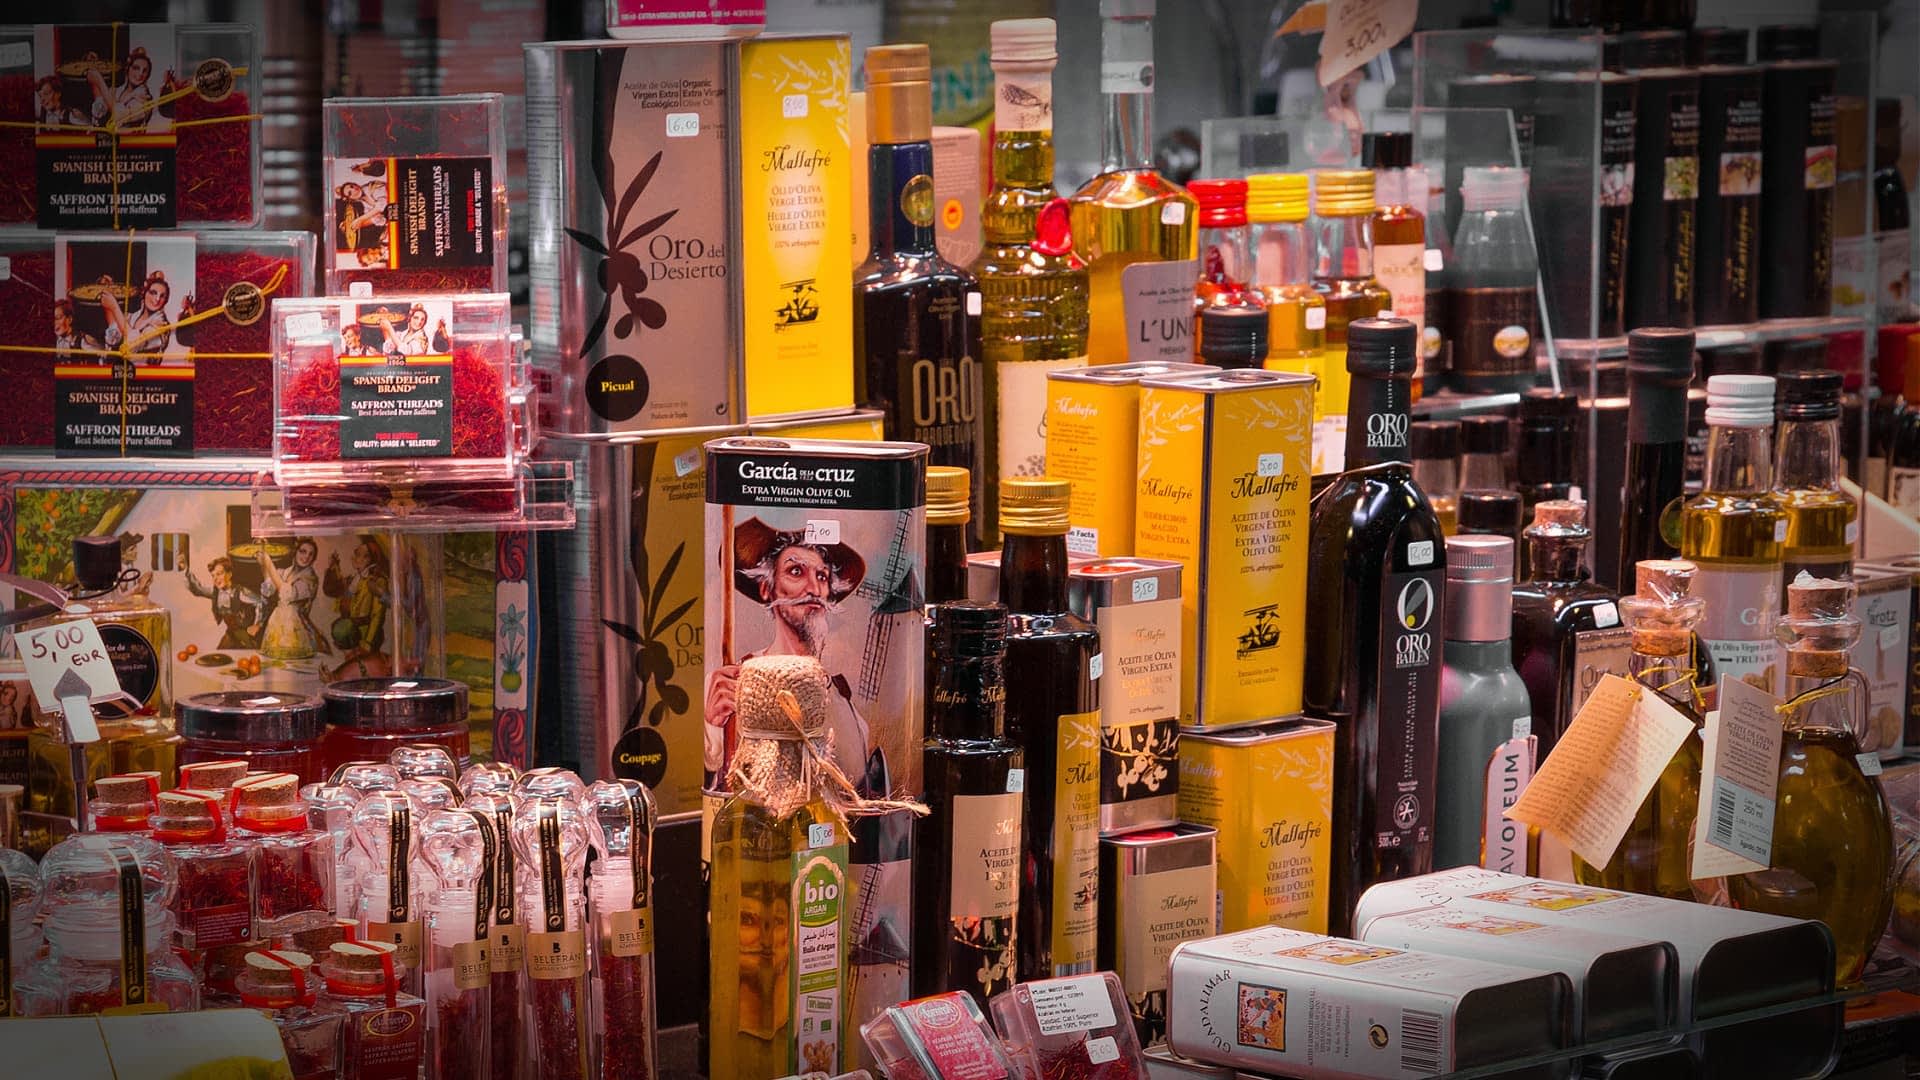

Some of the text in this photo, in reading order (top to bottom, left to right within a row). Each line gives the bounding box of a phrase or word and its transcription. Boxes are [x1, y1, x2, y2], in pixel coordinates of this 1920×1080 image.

[648, 80, 658, 89] de
[660, 80, 678, 89] Oliva
[682, 79, 712, 89] Organic
[632, 90, 679, 100] Virgen Extra
[682, 88, 702, 98] Extra
[641, 100, 679, 110] Ecológico
[52, 161, 163, 173] SPANISH DELIGHT
[761, 145, 831, 177] Mallafré
[407, 168, 418, 213] DELIGHT
[50, 193, 166, 205] SAFFRON THREADS
[797, 195, 824, 206] EXTRA
[59, 204, 76, 214] Best
[77, 204, 109, 214] Selected
[128, 204, 158, 214] Saffron
[432, 166, 445, 257] SAFFRON THREADS
[799, 220, 826, 231] EXTRA
[408, 214, 419, 255] SPANISH
[649, 234, 726, 260] Oro del
[650, 260, 727, 281] Desierto
[353, 374, 441, 385] SPANISH DELIGHT
[601, 379, 635, 393] Picual
[68, 391, 178, 405] SPANISH DELIGHT
[351, 398, 443, 410] SAFFRON THREADS
[358, 407, 437, 417] Best Selected Pure Saffron
[66, 424, 181, 436] SAFFRON THREADS
[1366, 412, 1409, 436] ORO
[75, 436, 172, 447] Best Selecte Pure Saffron
[354, 439, 379, 448] QUALITY:
[380, 439, 399, 448] GRADE
[400, 439, 405, 448] A
[1366, 432, 1408, 448] BAILEN
[738, 461, 798, 481] García
[815, 467, 856, 482] cruz
[742, 484, 852, 498] EXTRA VIRGIN OLIVE OIL
[1141, 477, 1193, 504] Mallafré
[1231, 472, 1299, 501] Mallafré
[755, 495, 773, 503] ACEITE
[782, 496, 798, 504] OLIVA
[799, 497, 819, 505] VIRGEN
[1231, 508, 1296, 524] ACEITE DE OLIVA
[1235, 519, 1292, 534] VIRGEN EXTRA
[1076, 529, 1095, 539] Facts
[1166, 535, 1190, 545] EXTRA
[1235, 533, 1291, 547] EXTRA VIRGIN
[1242, 544, 1282, 557] OLIVE OIL
[31, 626, 84, 663] 5,00
[1396, 632, 1431, 656] ORO
[71, 649, 105, 666] EUR
[1118, 650, 1177, 666] ACEITE DE OLIVA
[1396, 649, 1430, 666] BAILEN
[1122, 662, 1173, 676] VIRGEN EXTRA
[620, 751, 662, 765] Coupage
[1743, 805, 1764, 818] 250 ml
[1260, 821, 1322, 849] Mallafré
[980, 848, 1010, 858] ACEITE
[984, 858, 1014, 869] VIRGEN
[1266, 865, 1314, 882] VERGE EXTRA
[804, 882, 838, 905] bio
[1263, 884, 1286, 897] HUILE
[1291, 889, 1314, 902] EXTRA
[803, 903, 827, 916] ARGAN
[1160, 894, 1199, 911] Mallafré
[1149, 916, 1209, 933] ACEITE DE OLIVA
[1152, 927, 1206, 943] VIRGEN EXTRA
[1199, 968, 1233, 1055] GUADALIMAR
